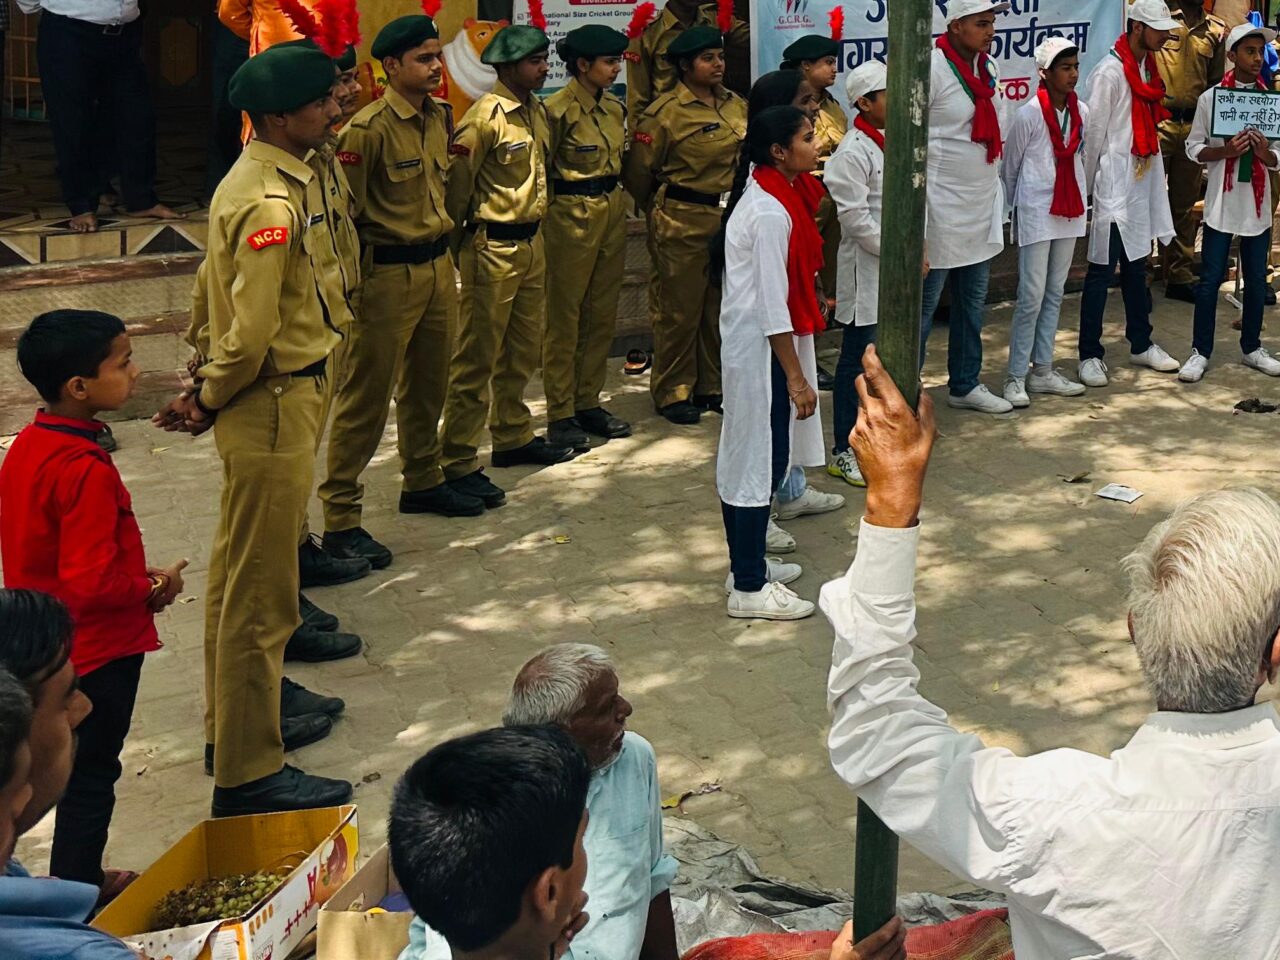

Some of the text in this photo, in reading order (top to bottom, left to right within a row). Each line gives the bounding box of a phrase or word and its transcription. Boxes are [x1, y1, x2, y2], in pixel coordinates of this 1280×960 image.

[589, 10, 613, 18] Cricket
[1236, 95, 1247, 104] का
[1249, 94, 1280, 106] सहयोग
[1220, 106, 1237, 121] पानी
[1239, 111, 1250, 121] का
[1251, 108, 1267, 122] नहीं
[253, 229, 283, 246] NCC
